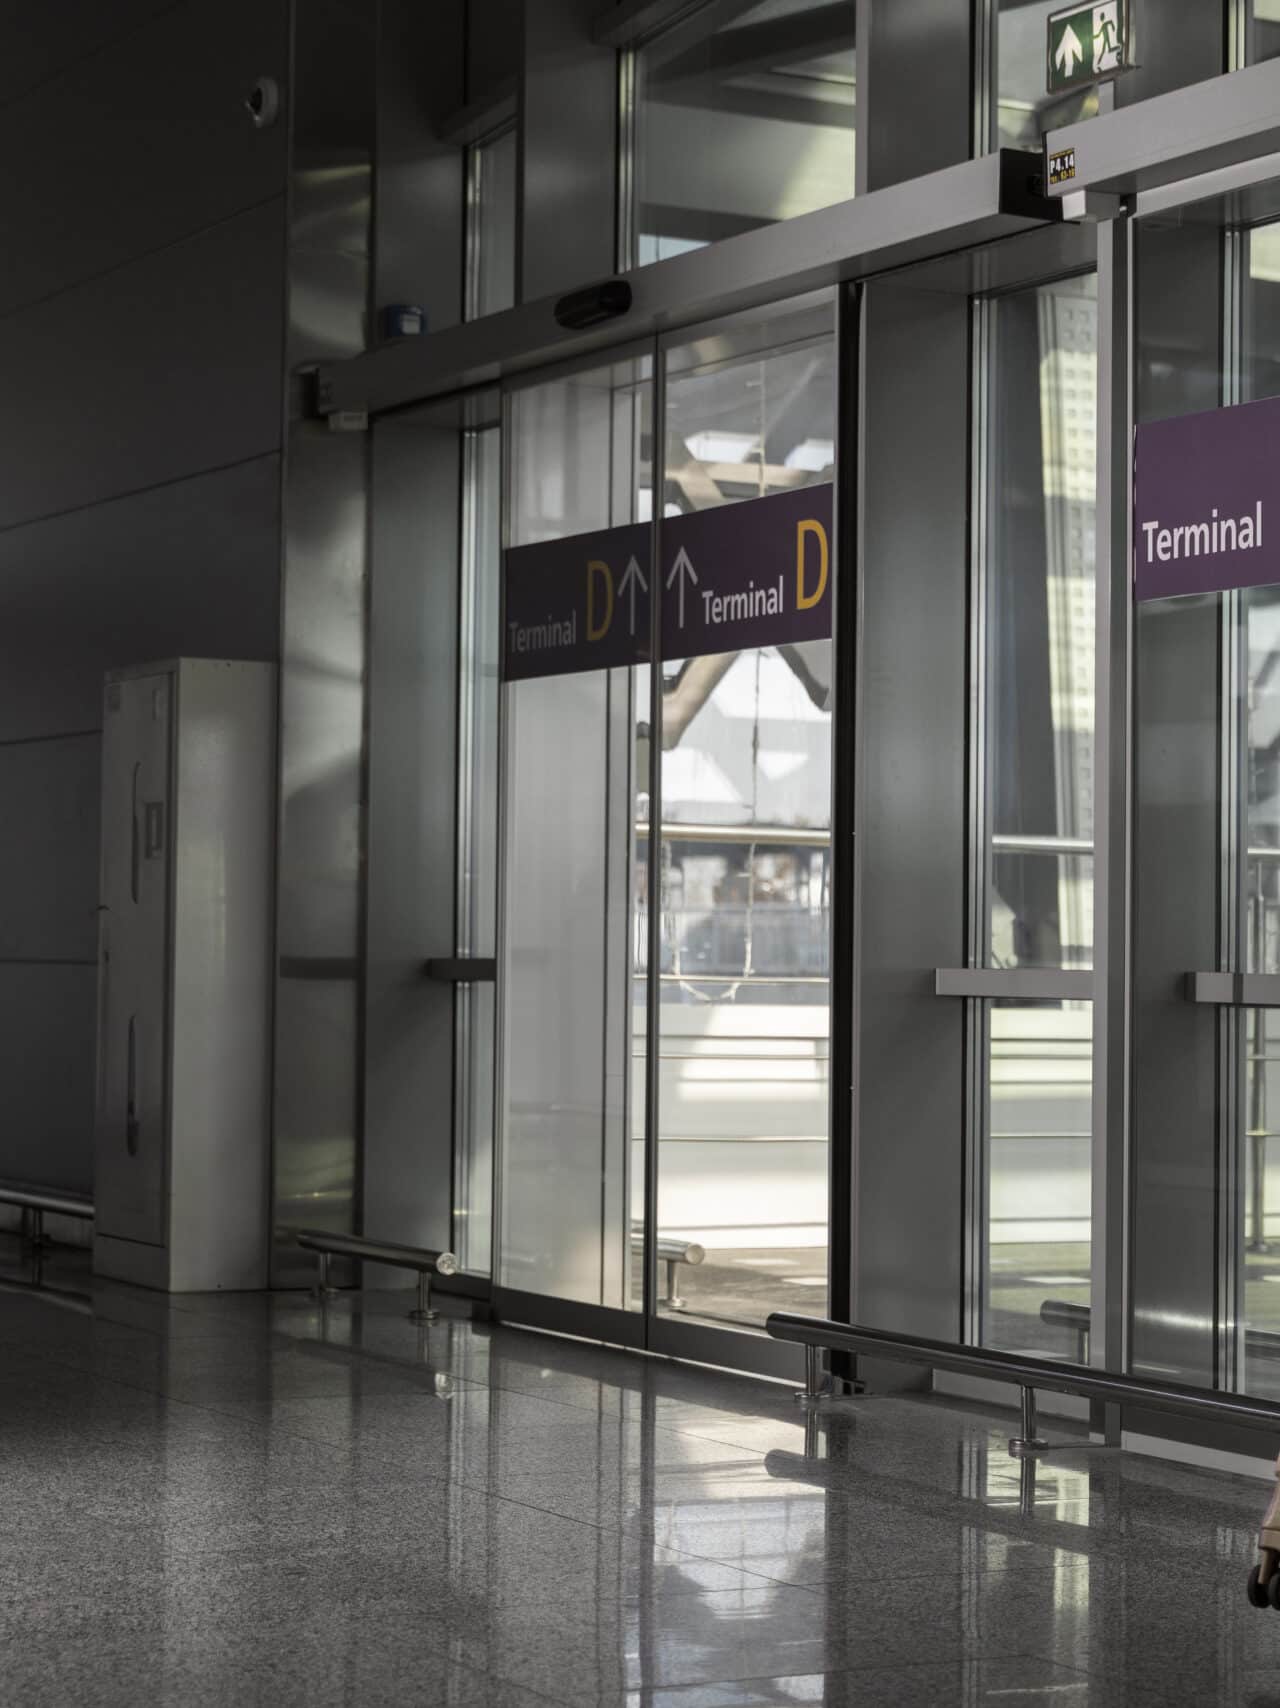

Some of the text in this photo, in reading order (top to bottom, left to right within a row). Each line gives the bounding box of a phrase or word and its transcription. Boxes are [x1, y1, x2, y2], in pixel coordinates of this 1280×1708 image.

[702, 519, 828, 624] Terminal D
[1142, 501, 1262, 562] Terminal
[508, 560, 614, 652] Terminal D
